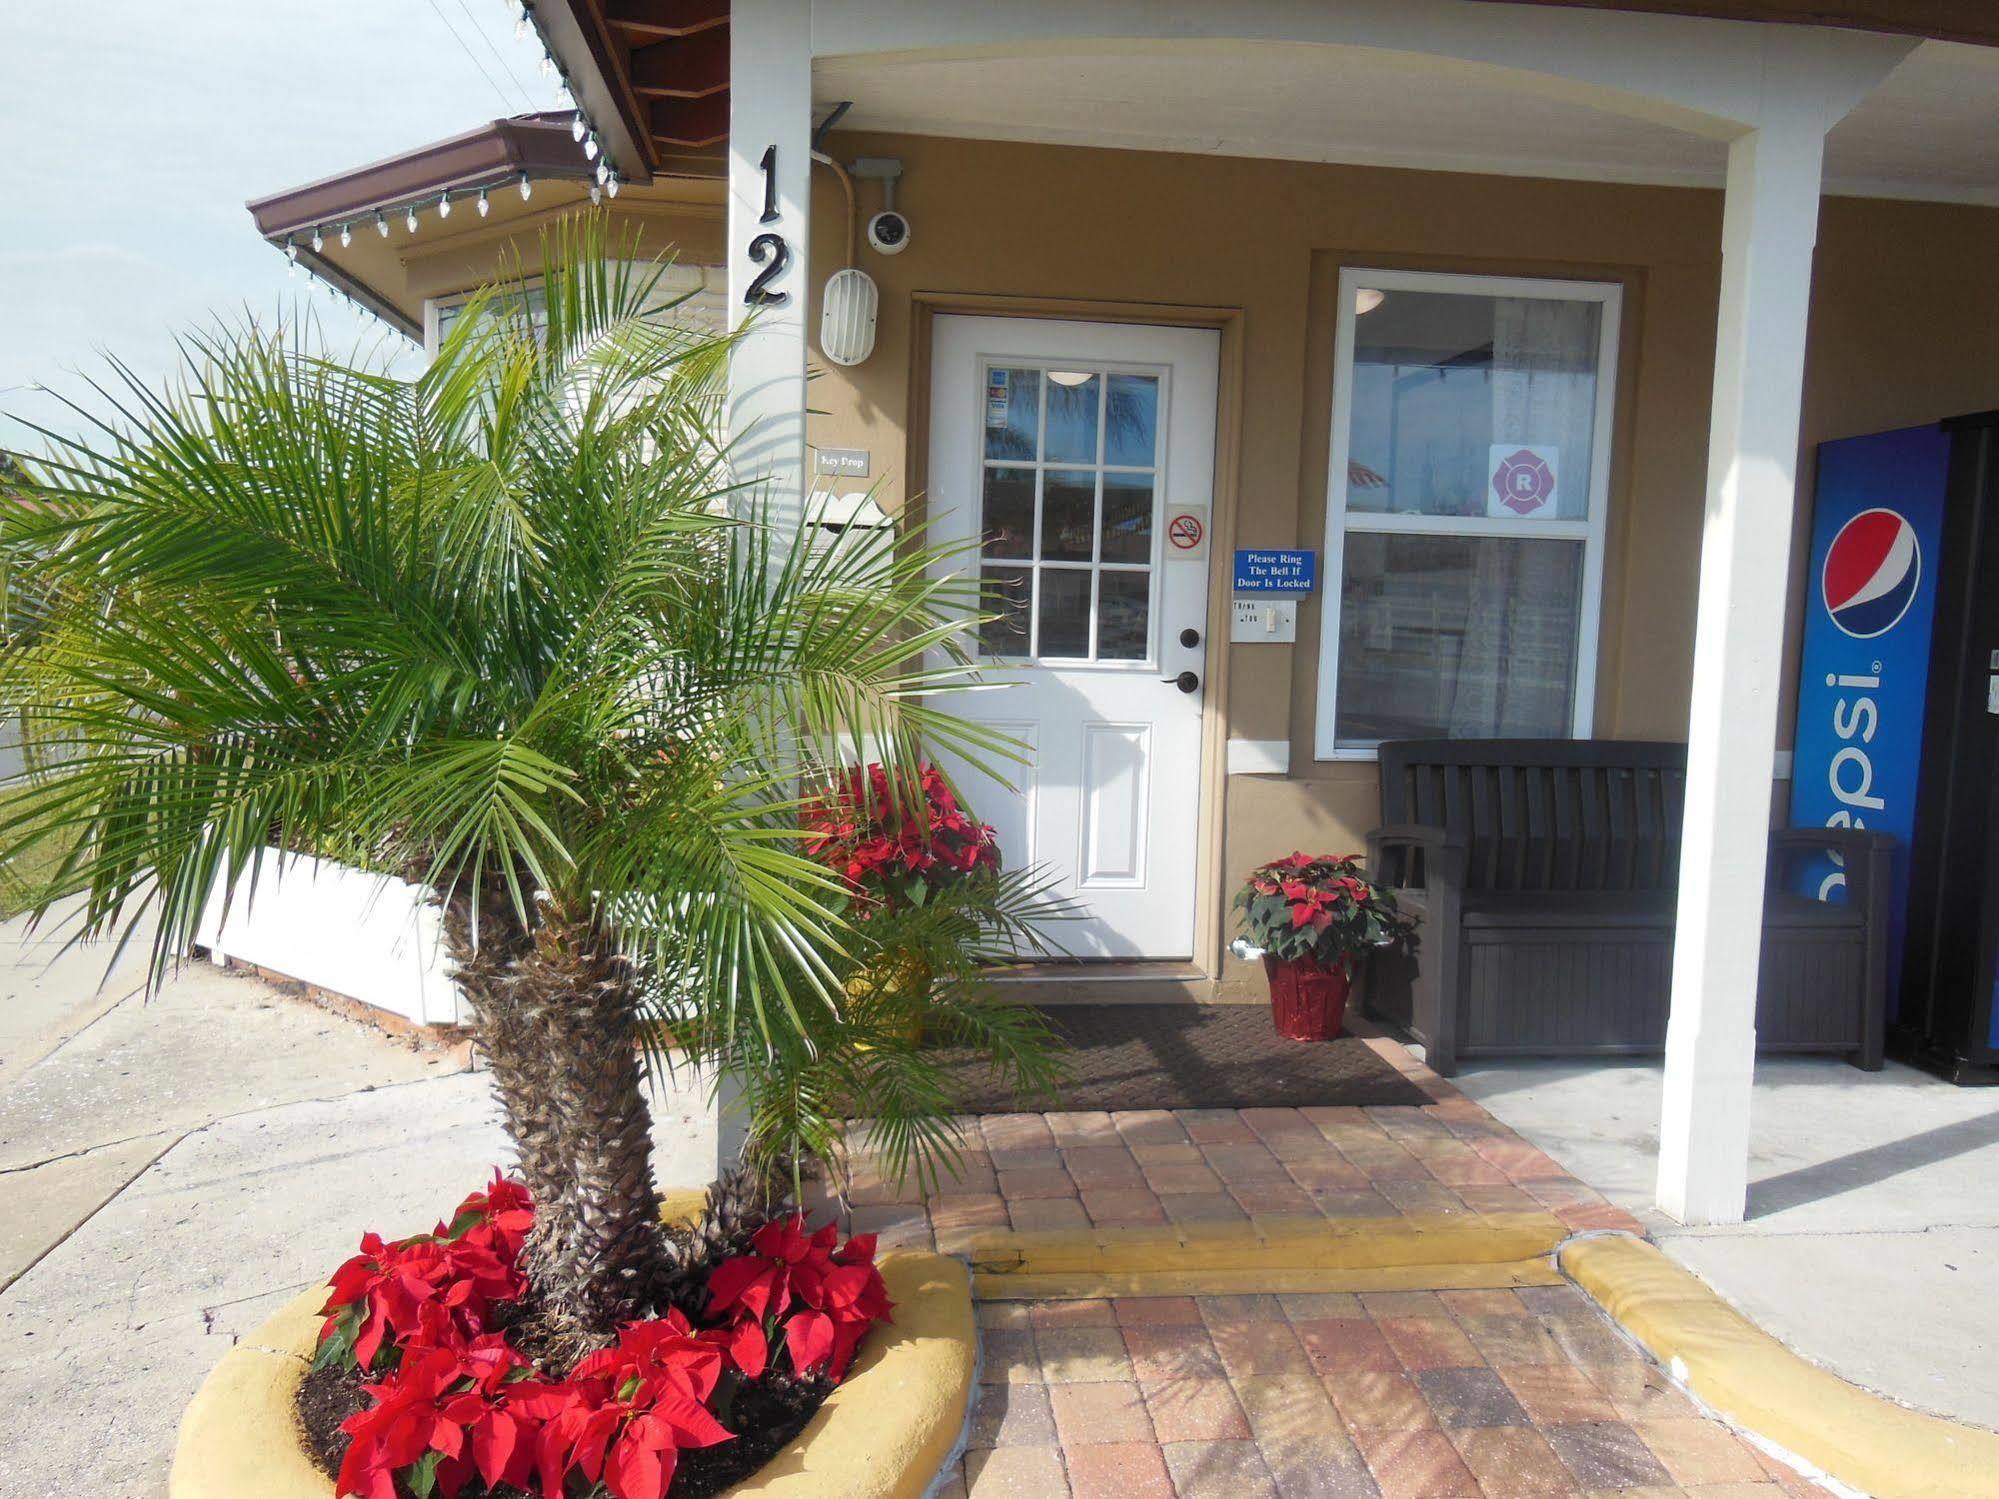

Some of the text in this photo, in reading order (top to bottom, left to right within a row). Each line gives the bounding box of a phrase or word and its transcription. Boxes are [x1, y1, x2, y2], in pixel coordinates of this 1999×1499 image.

[841, 456, 864, 469] Drop
[1516, 473, 1533, 491] R
[1247, 553, 1302, 566] Please Ring
[1249, 566, 1302, 576] The Bell If
[1237, 577, 1311, 588] Door Is Locked
[1817, 672, 1885, 902] psi
